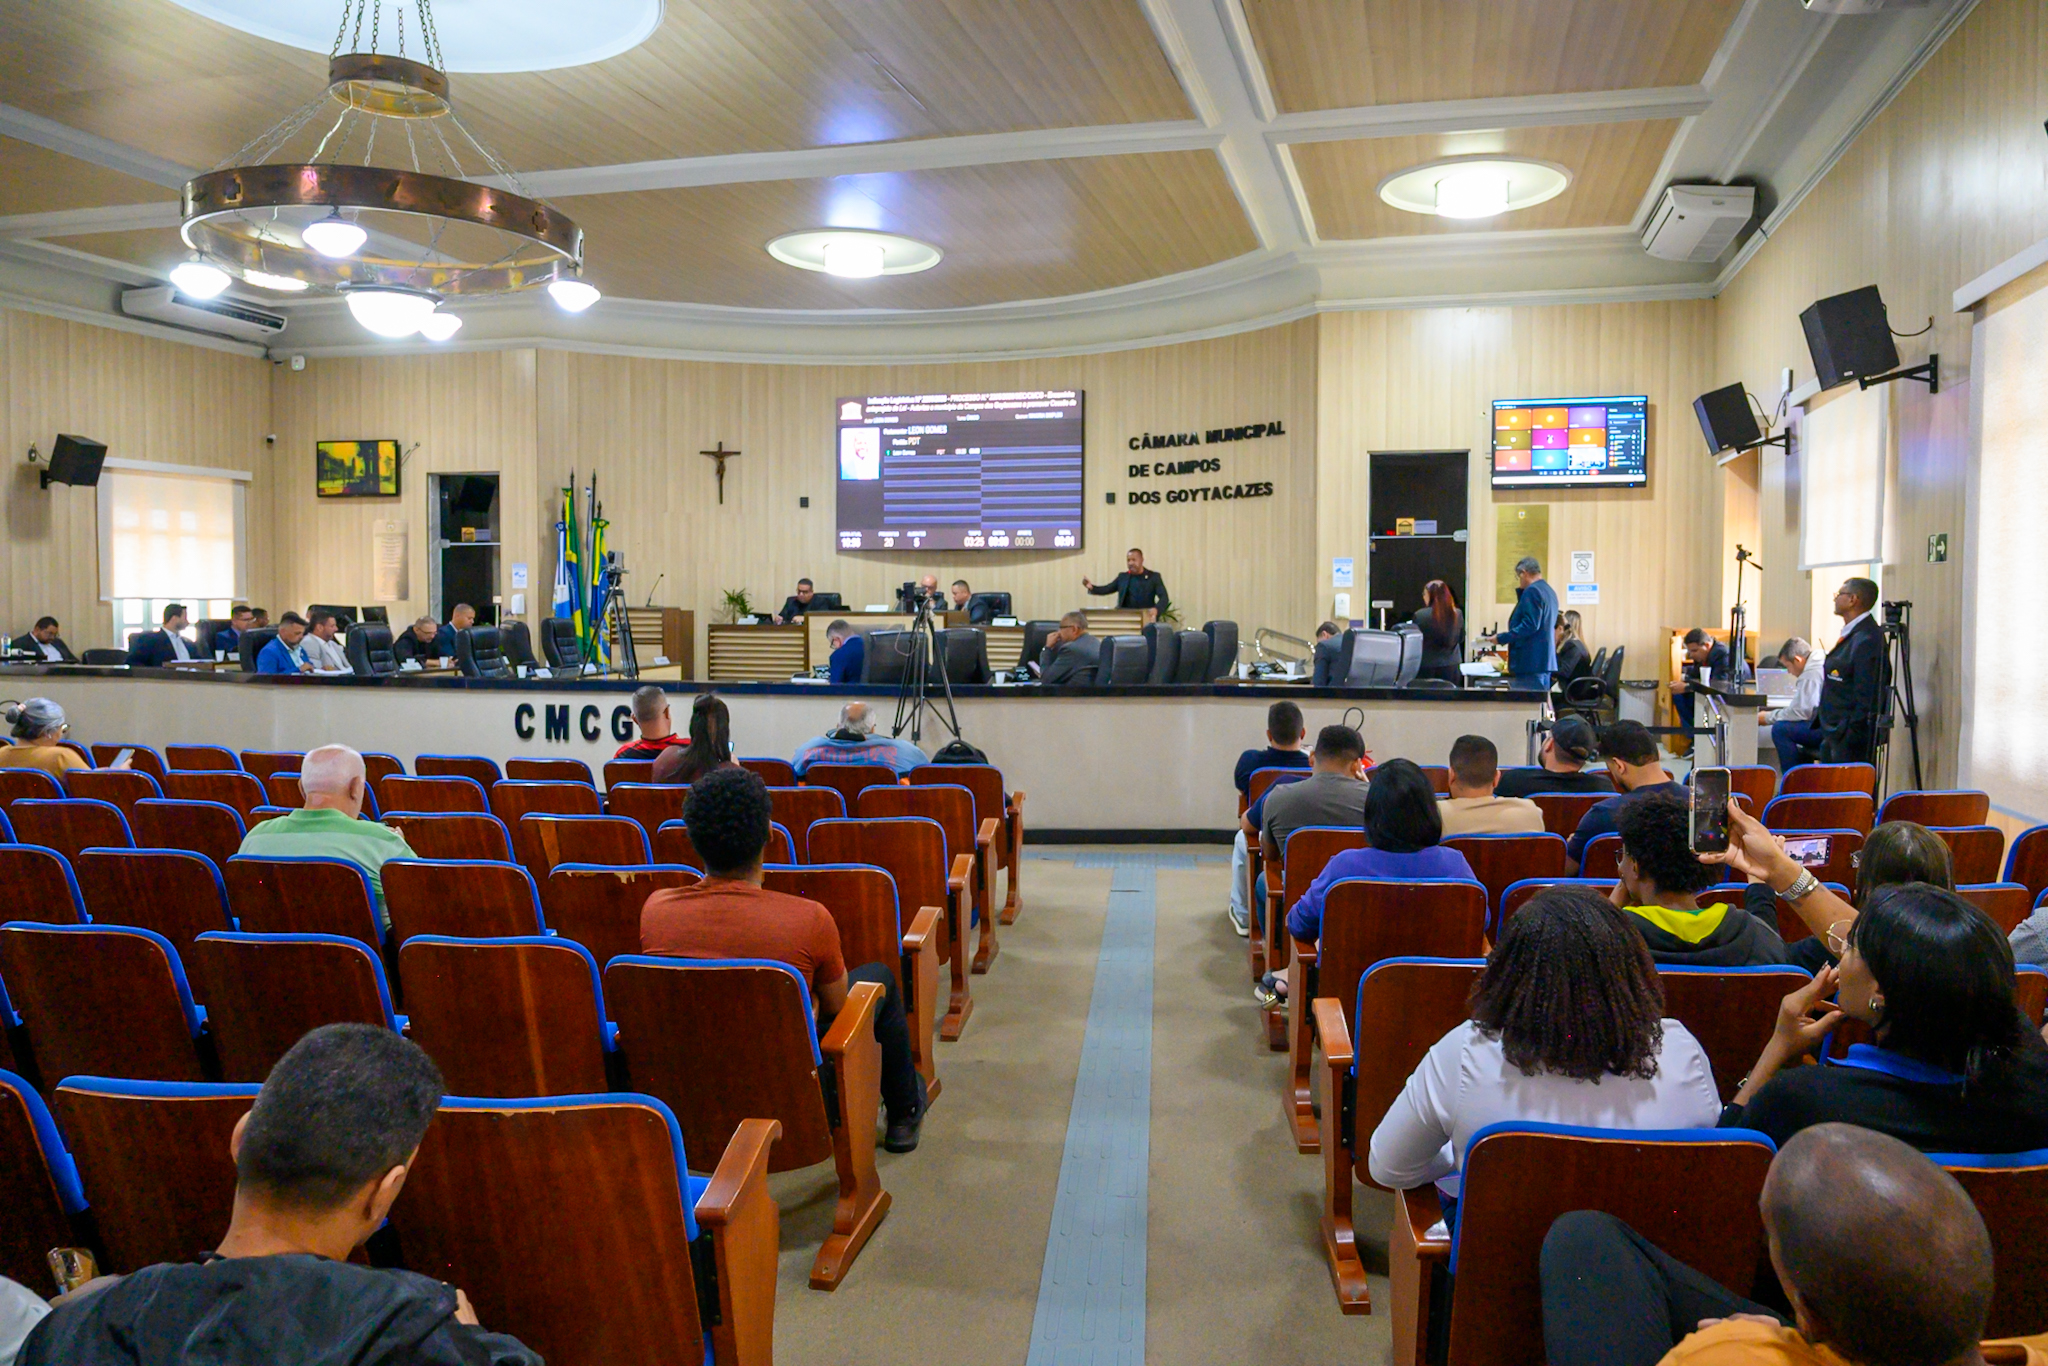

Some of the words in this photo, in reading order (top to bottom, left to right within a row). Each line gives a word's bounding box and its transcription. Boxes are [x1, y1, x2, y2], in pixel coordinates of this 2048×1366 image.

[908, 437, 921, 445] PDT
[1128, 432, 1200, 450] CÂMARA
[1205, 421, 1286, 444] MUNICIPAL
[1128, 464, 1149, 478] DE
[1153, 458, 1221, 476] CAMPOS
[1128, 491, 1161, 505] DOS
[1166, 481, 1273, 504] GOYTACAZES
[883, 537, 894, 548] 20
[963, 536, 985, 547] 03:25
[1014, 536, 1035, 547] 00:00
[515, 703, 633, 741] CMCG
